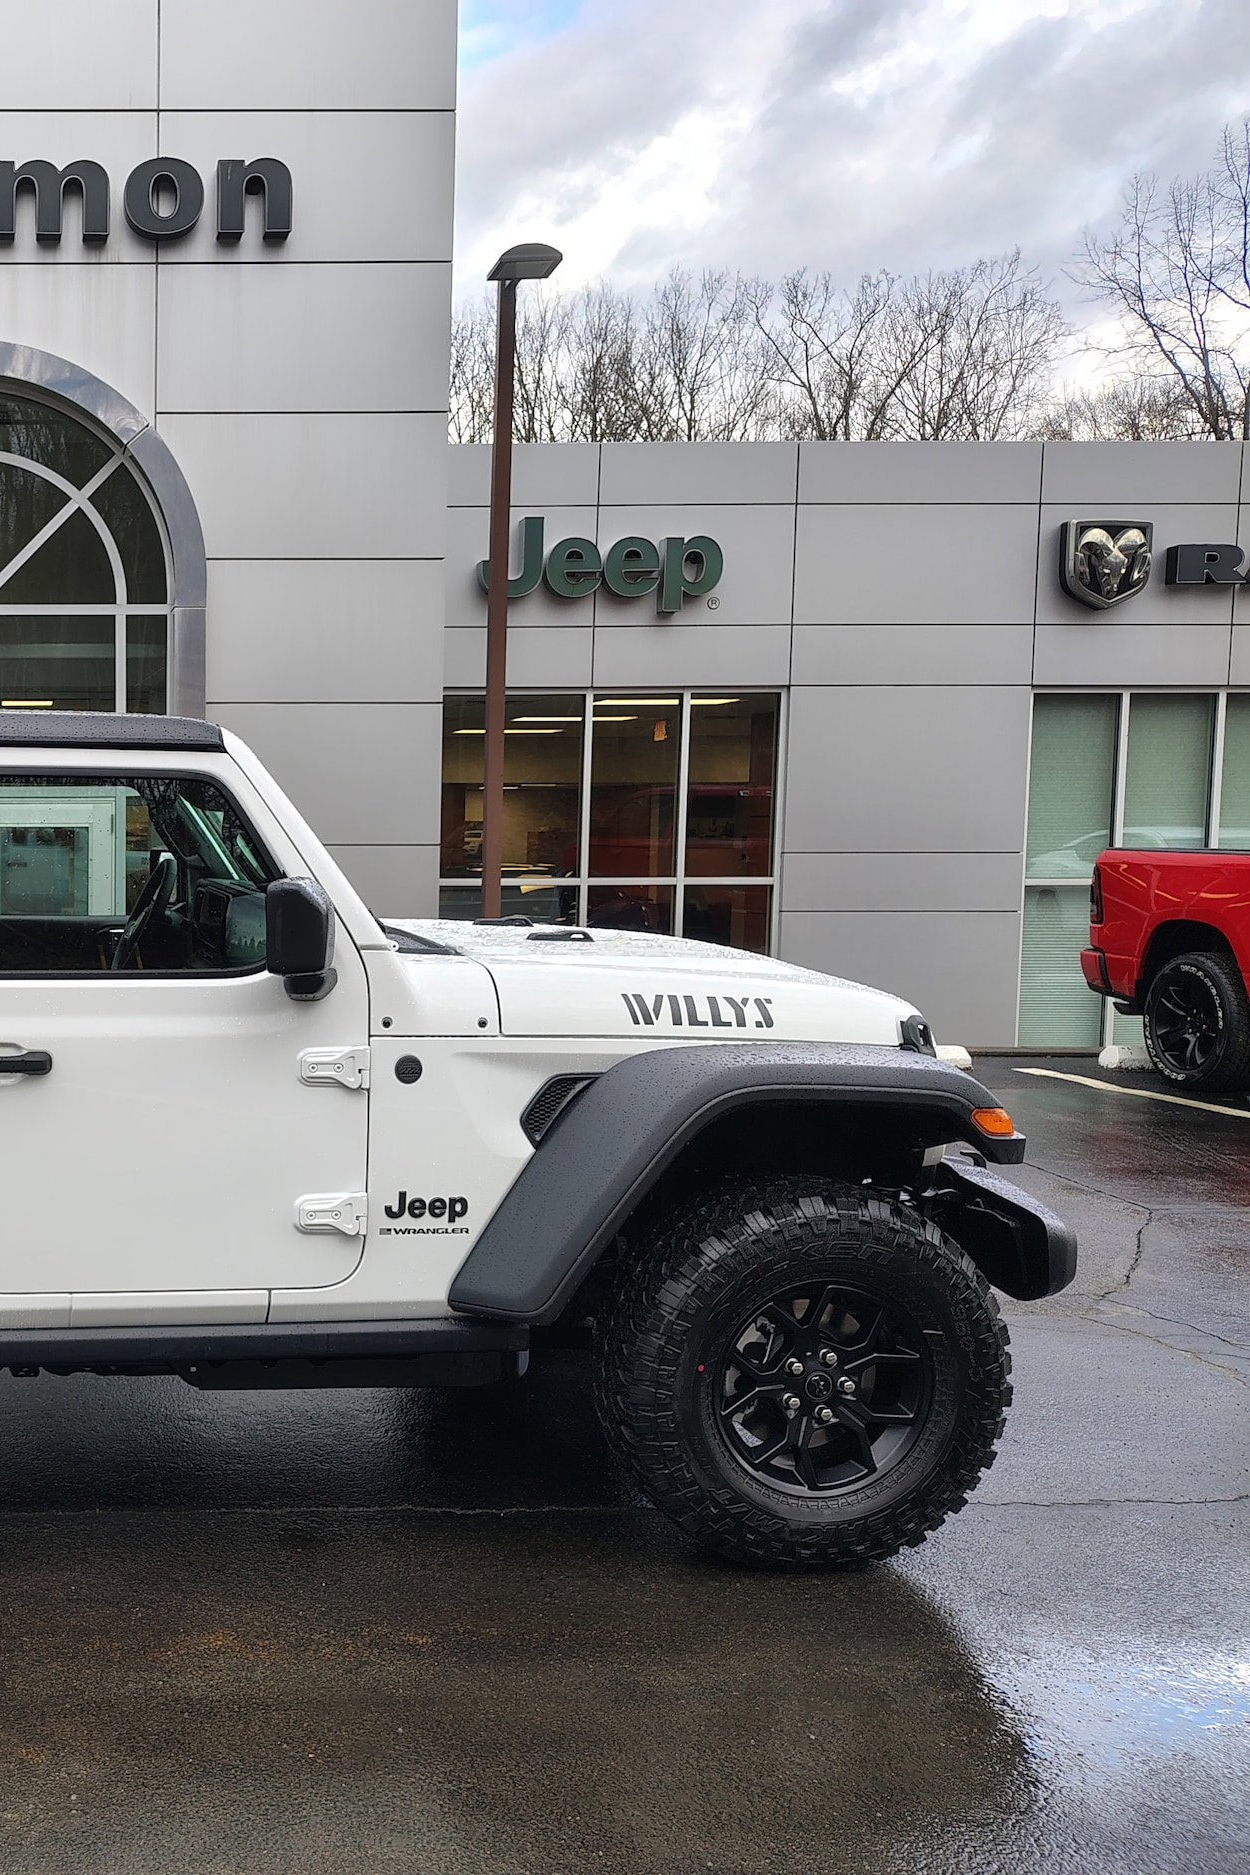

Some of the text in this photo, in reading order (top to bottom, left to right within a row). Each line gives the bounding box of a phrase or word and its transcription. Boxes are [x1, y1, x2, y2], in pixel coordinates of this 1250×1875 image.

[477, 516, 724, 614] Jeep
[1165, 544, 1250, 585] R
[621, 993, 774, 1028] WILLYS
[384, 1190, 469, 1224] Jeep
[392, 1227, 470, 1235] WRANGLER
